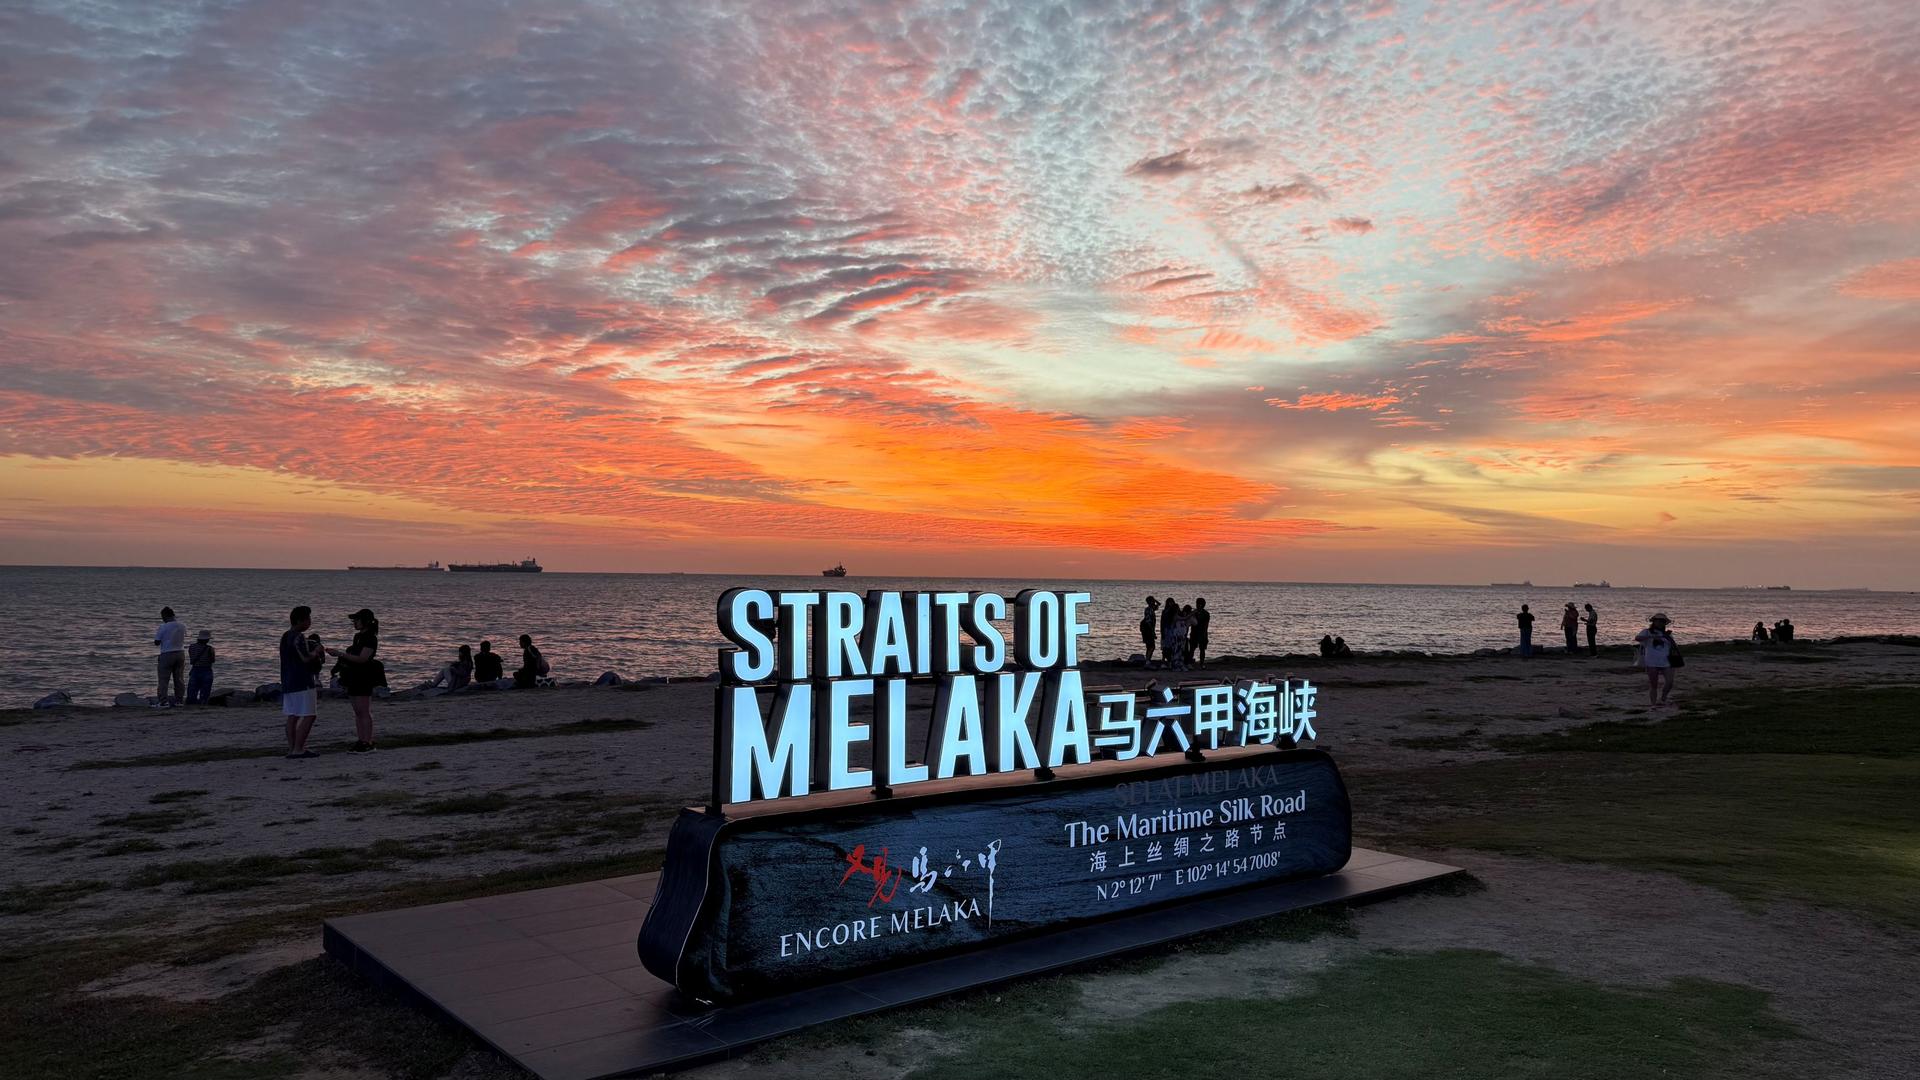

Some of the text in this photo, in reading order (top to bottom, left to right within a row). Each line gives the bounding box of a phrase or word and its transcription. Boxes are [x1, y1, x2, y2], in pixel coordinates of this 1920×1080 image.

[731, 589, 1091, 681] STRAITS OF
[731, 670, 1091, 803] MELAKA
[1094, 680, 1318, 761] 马六甲海峡
[1191, 764, 1280, 796] MELAKA
[1064, 790, 1306, 848] The Maritime Silk Road
[1089, 820, 1287, 873] 海上丝绸之路节点
[1096, 883, 1108, 902] N
[1175, 869, 1184, 886] E
[779, 897, 981, 958] ENCORE MELAKA
